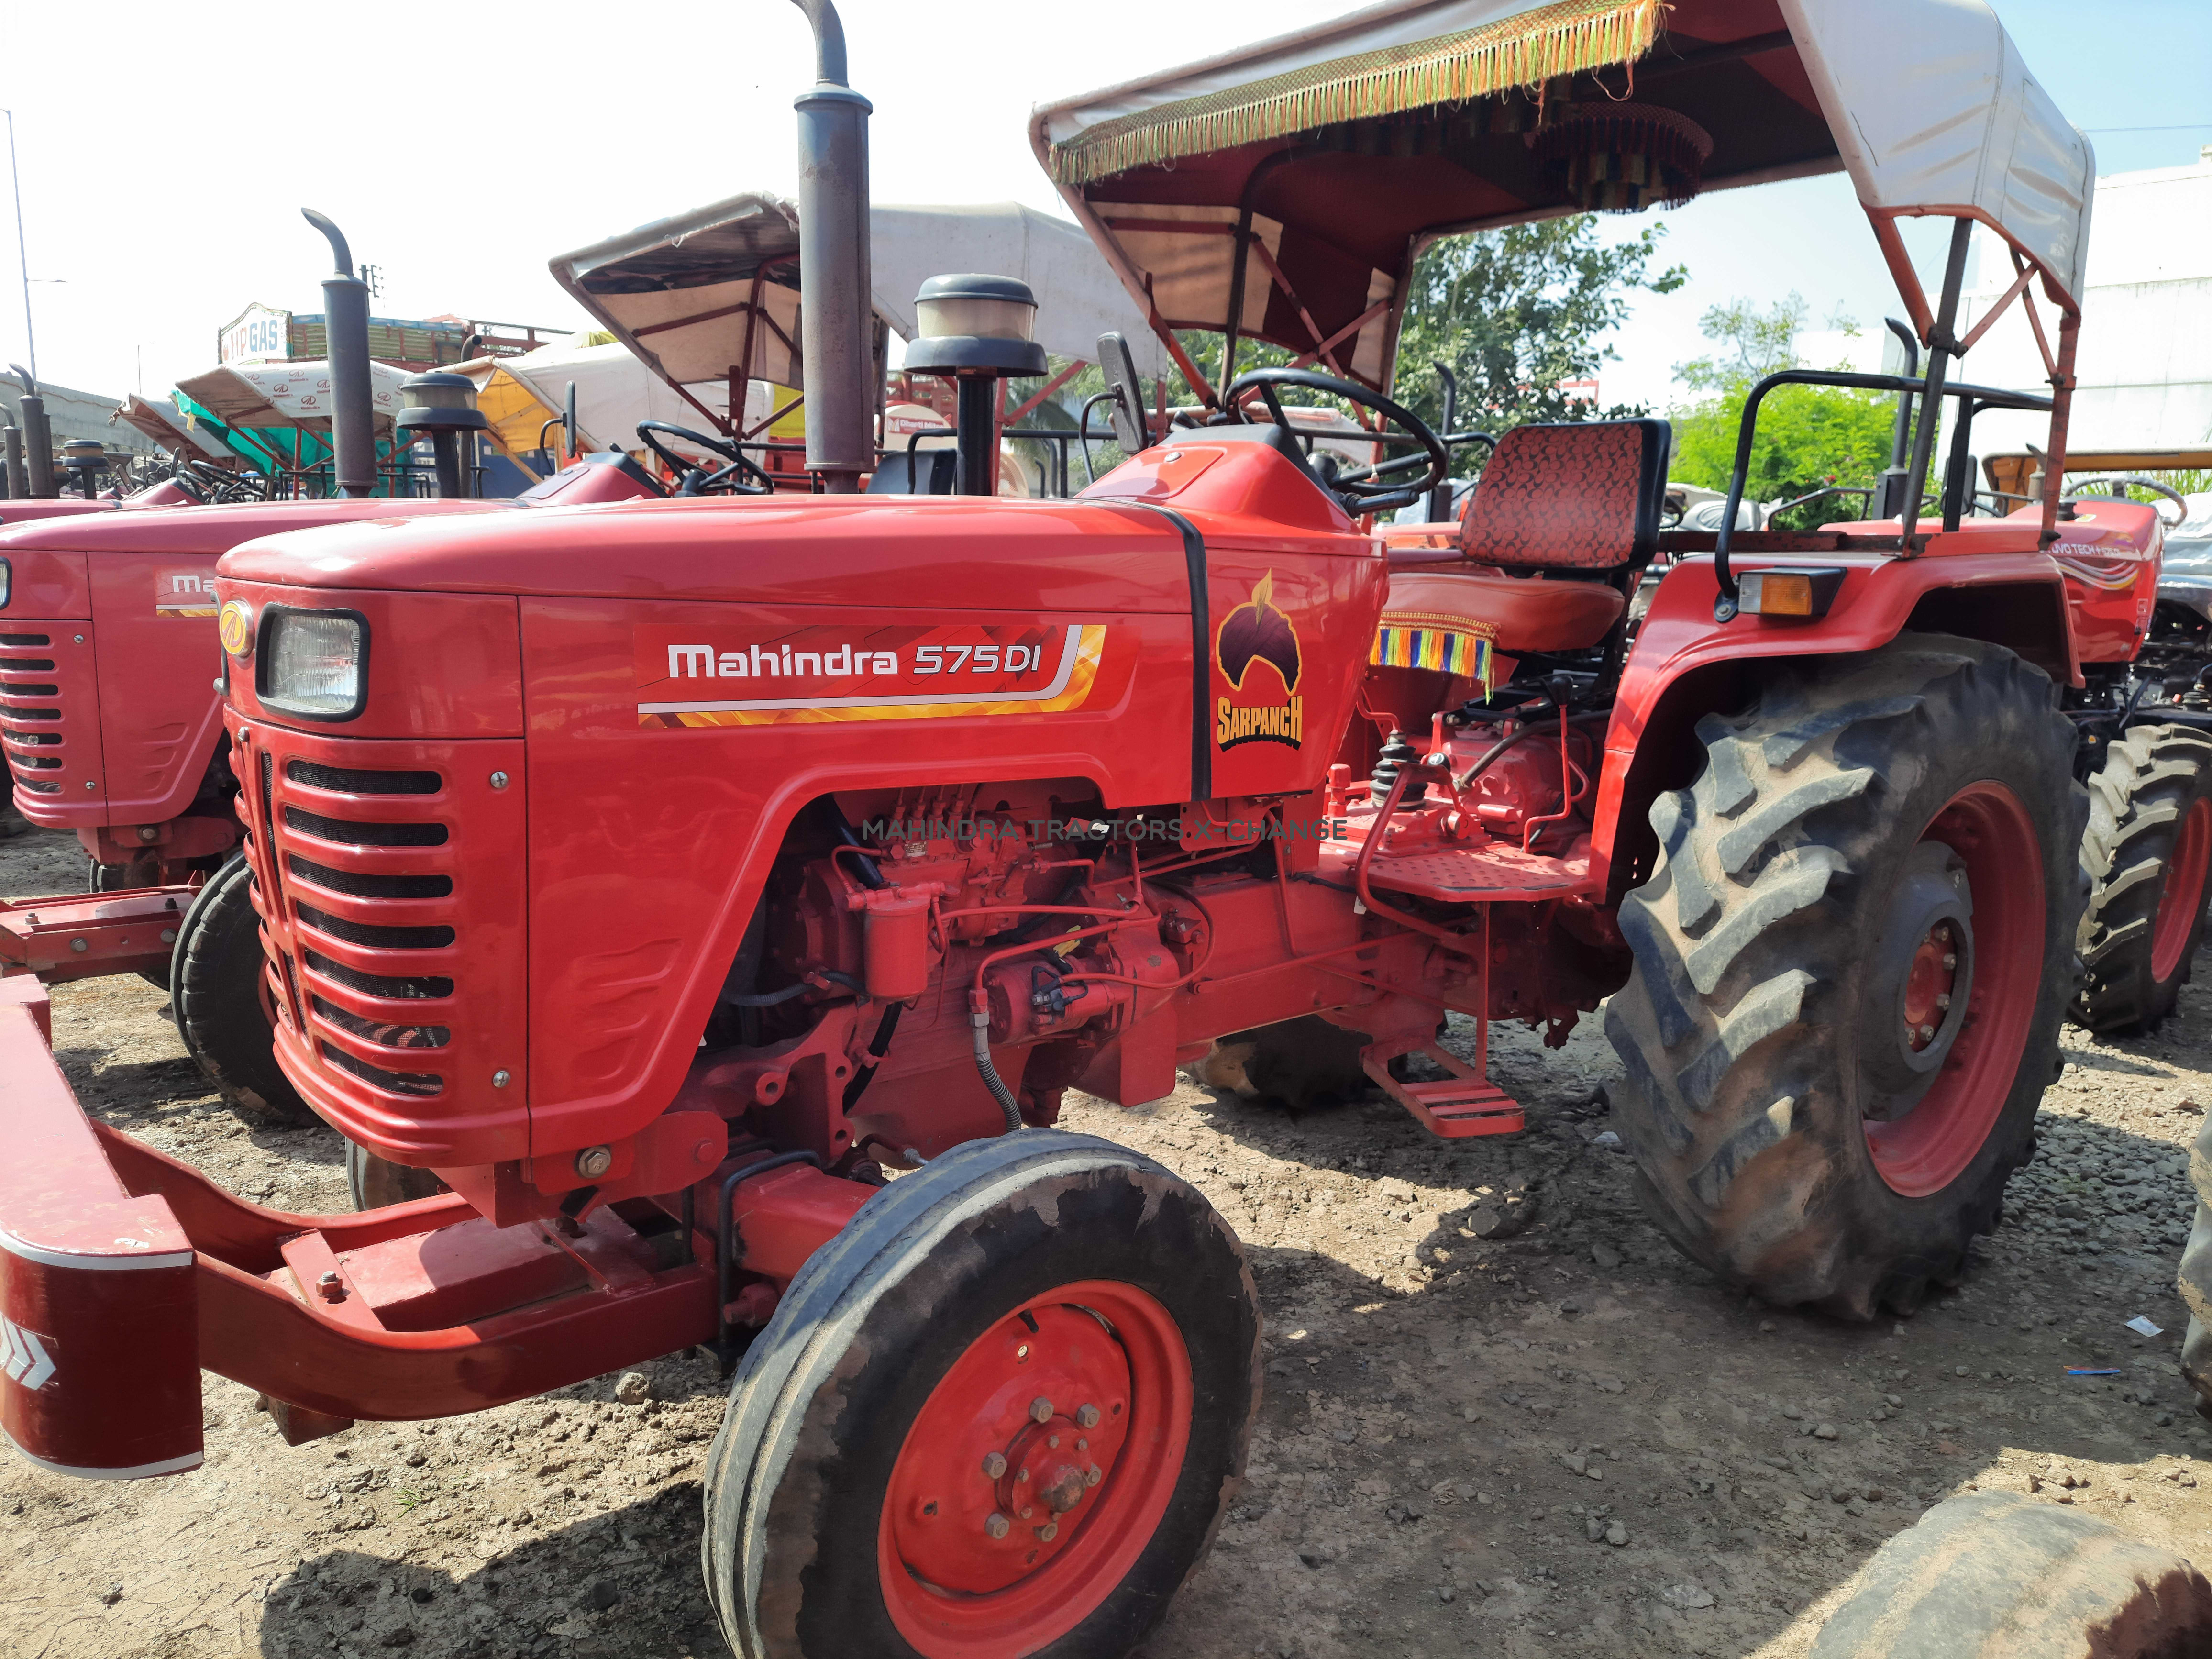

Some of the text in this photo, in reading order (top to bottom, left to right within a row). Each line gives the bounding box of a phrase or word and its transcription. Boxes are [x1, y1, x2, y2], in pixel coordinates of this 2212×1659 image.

[249, 320, 277, 352] GAS
[2048, 543, 2072, 554] UVO
[668, 644, 898, 678] Mahindra
[1217, 695, 1302, 748] SARPANCH
